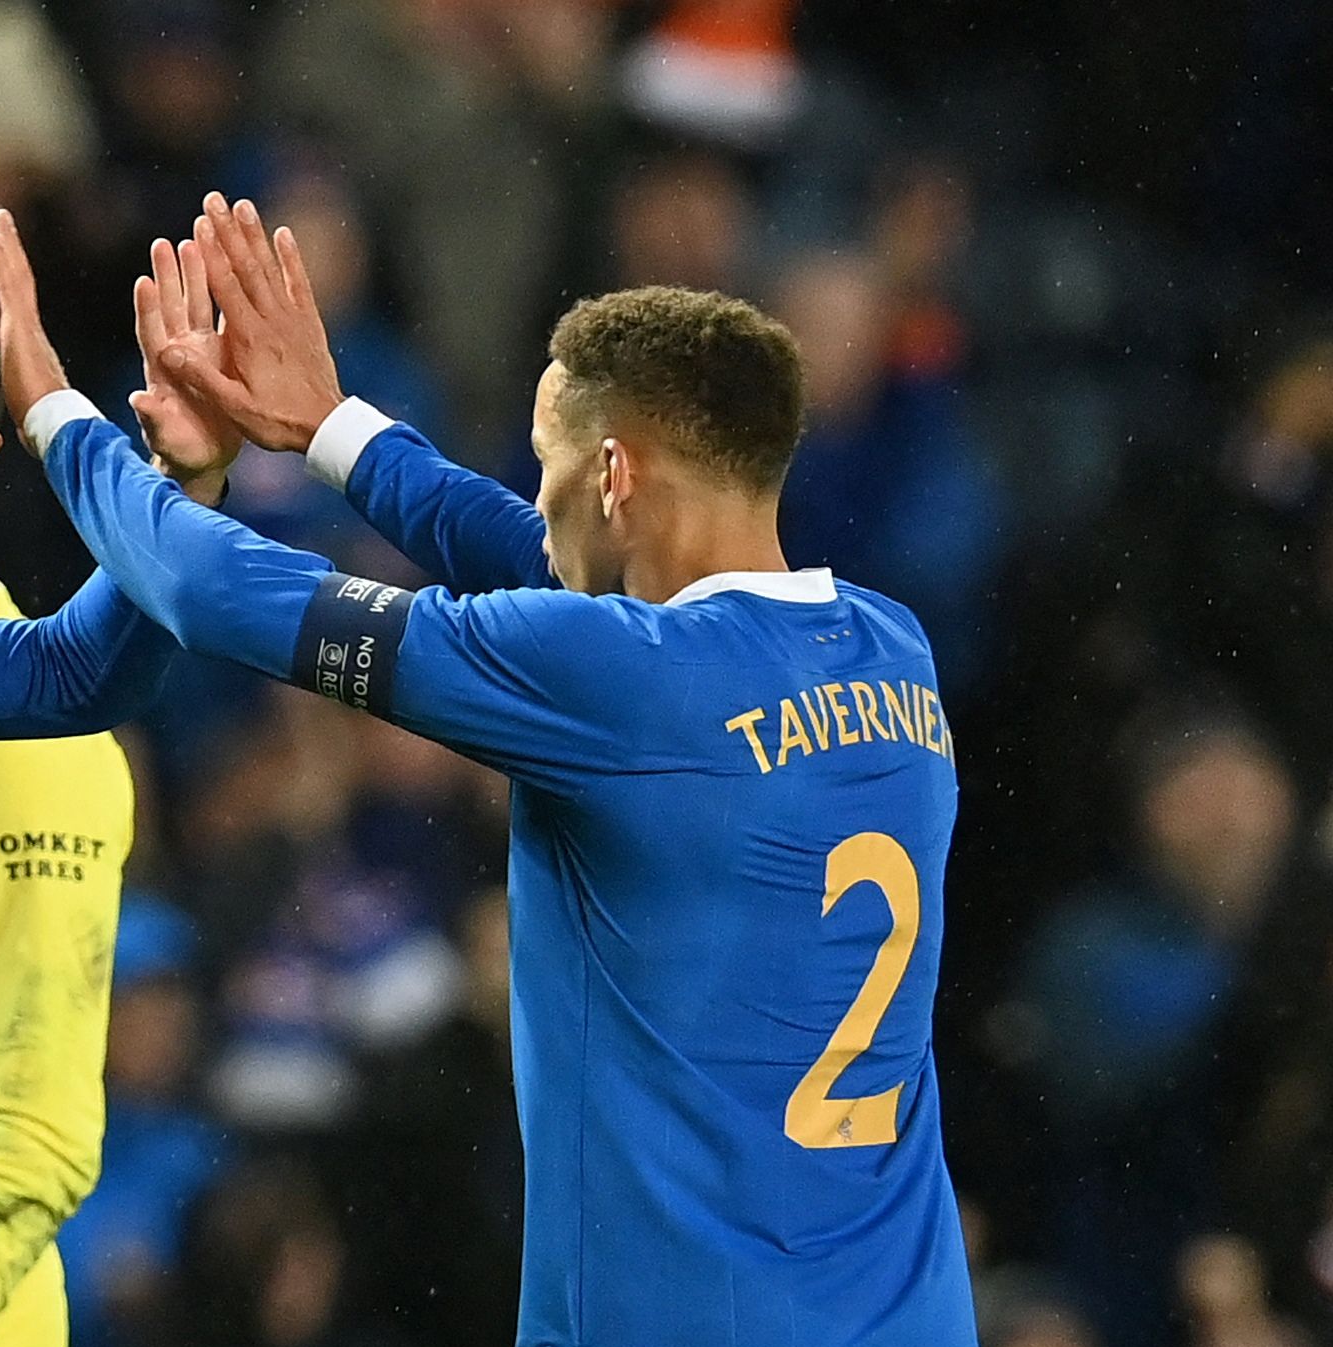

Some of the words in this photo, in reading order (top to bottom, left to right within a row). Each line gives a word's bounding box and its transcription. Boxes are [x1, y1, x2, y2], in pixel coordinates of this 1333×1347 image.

[356, 635, 375, 668] NO
[352, 672, 369, 695] TO
[4, 860, 83, 881] TIRES
[785, 832, 921, 1149] 2
